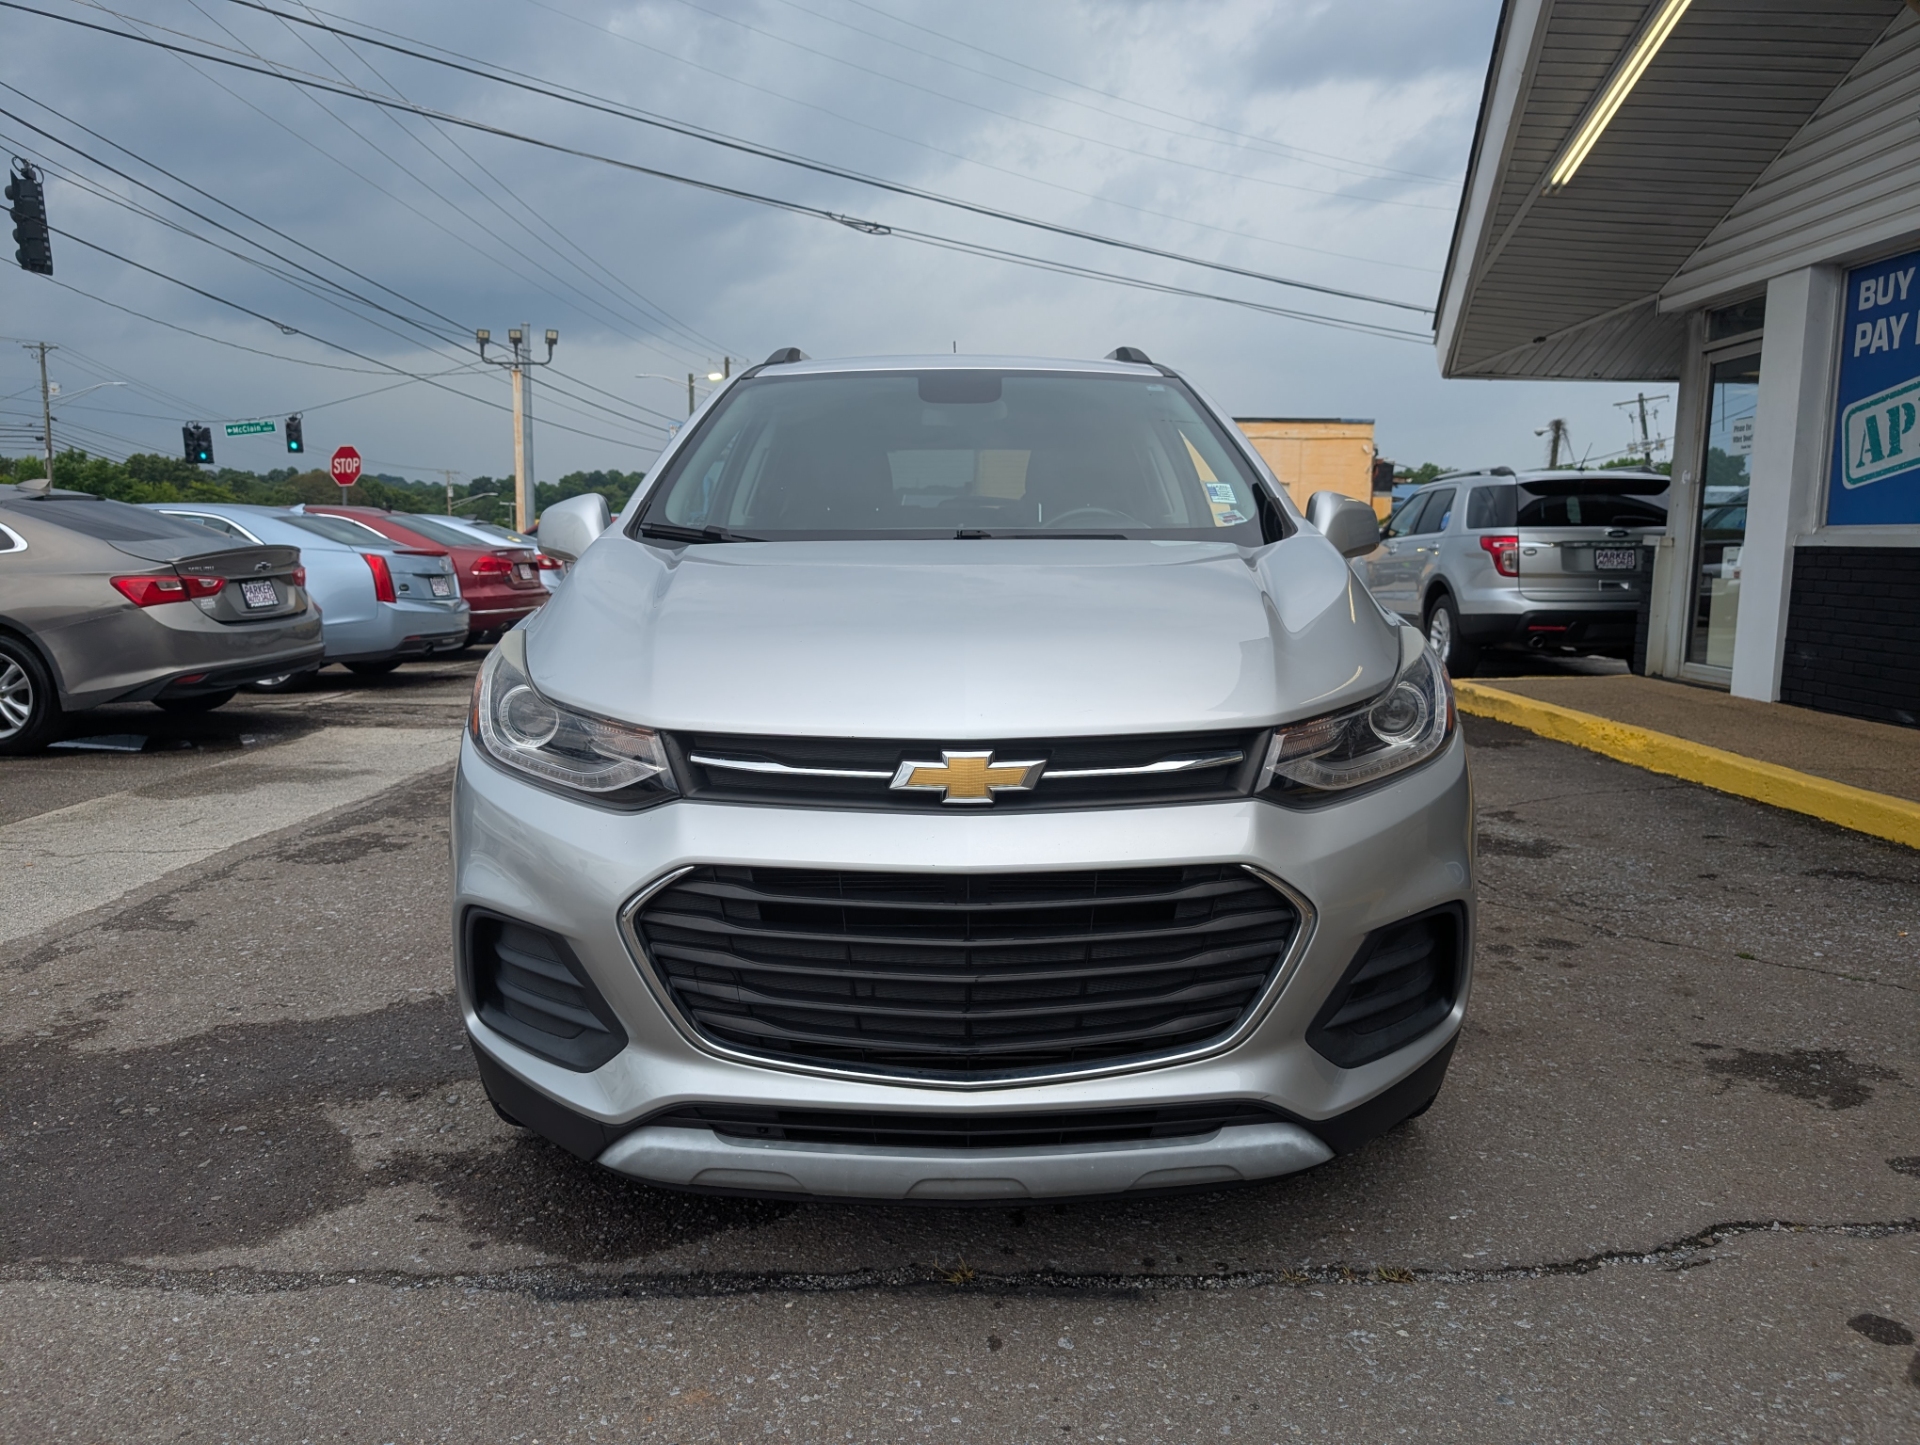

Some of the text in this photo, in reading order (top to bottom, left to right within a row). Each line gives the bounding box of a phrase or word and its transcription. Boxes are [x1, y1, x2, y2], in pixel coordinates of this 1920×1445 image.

[1858, 267, 1916, 311] BUY
[1853, 312, 1909, 358] PAY
[232, 424, 262, 434] McClain
[1855, 402, 1920, 468] AP
[333, 458, 360, 474] STOP
[1597, 551, 1633, 560] PARKER
[244, 584, 272, 595] PARKER
